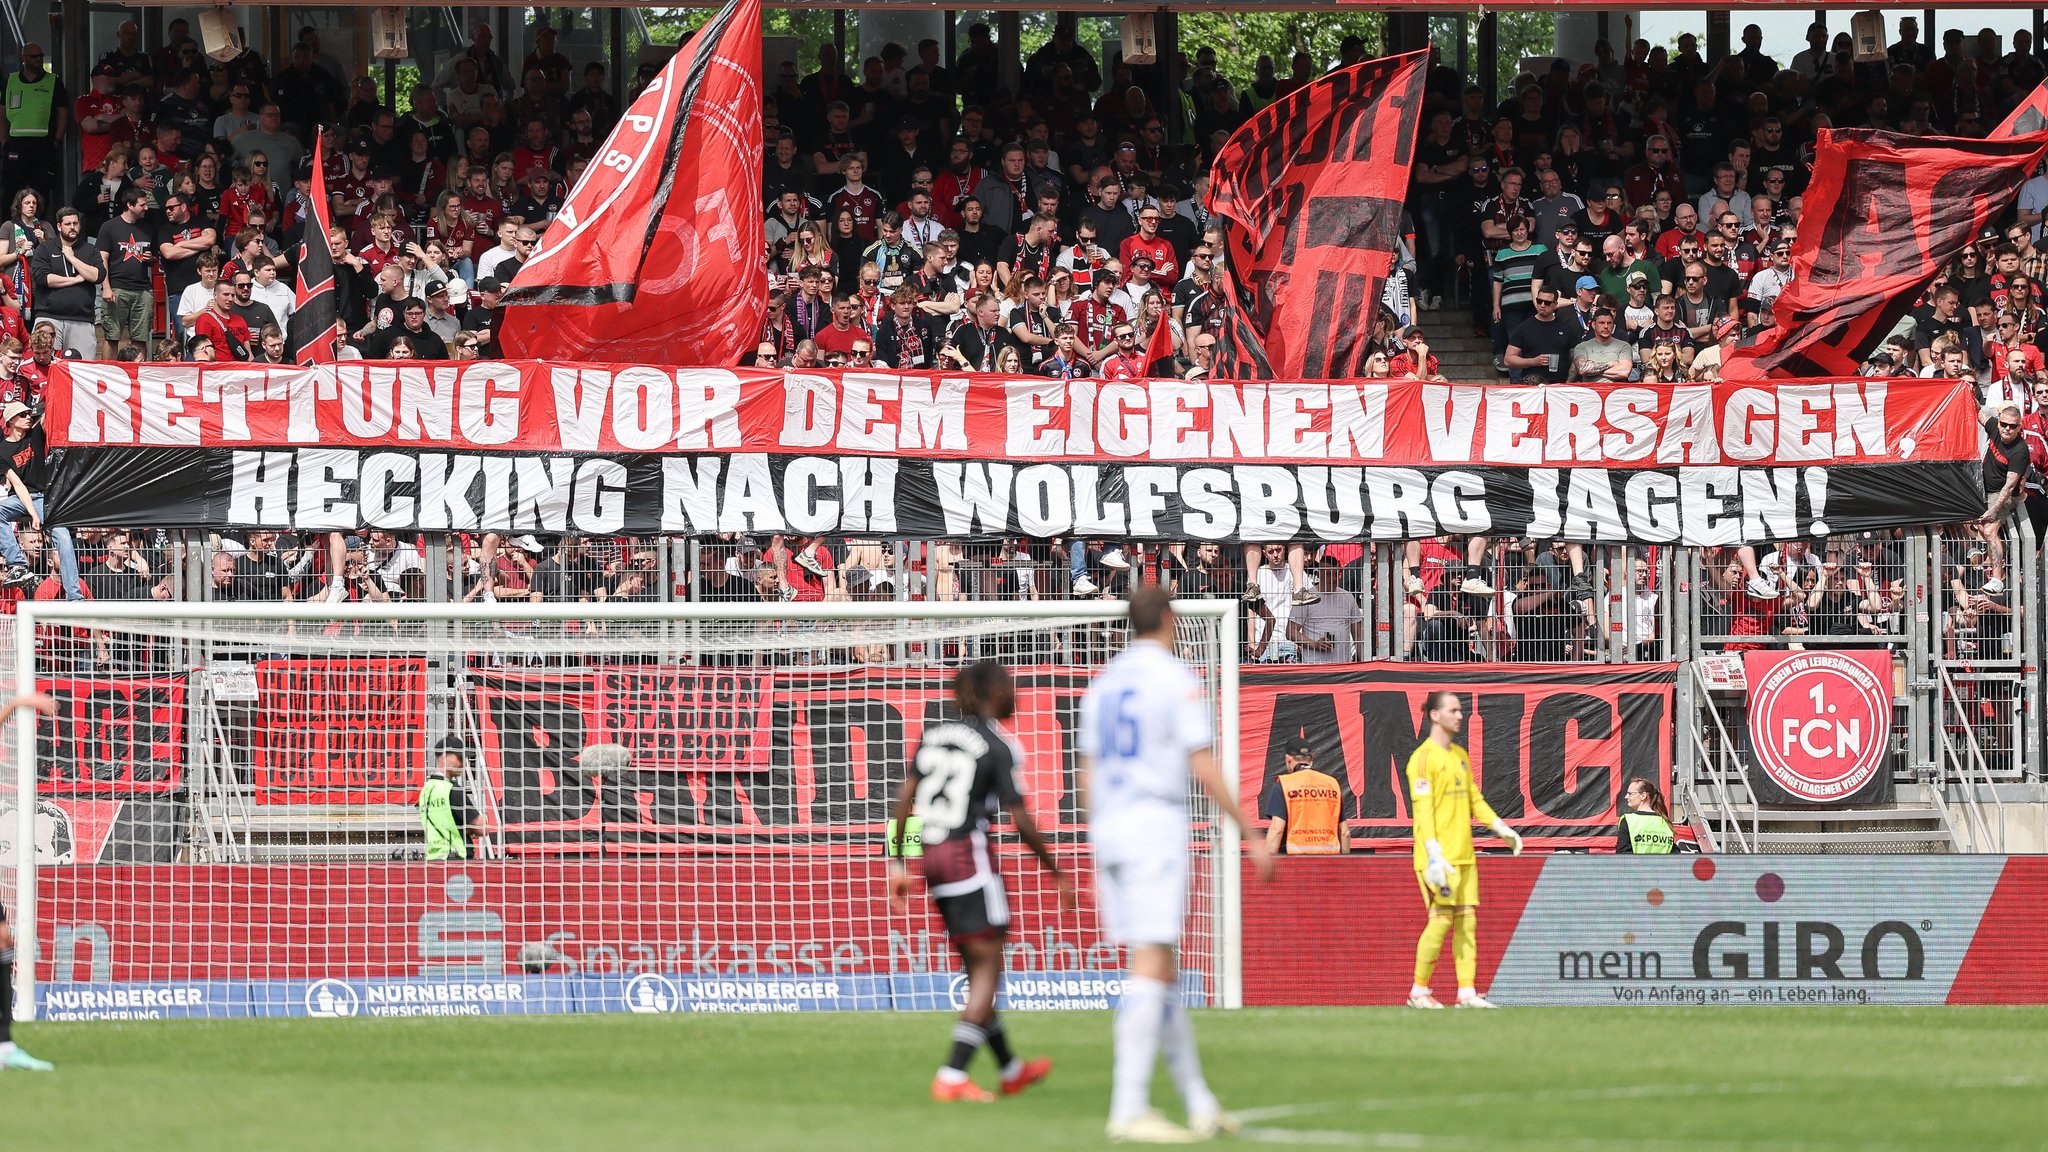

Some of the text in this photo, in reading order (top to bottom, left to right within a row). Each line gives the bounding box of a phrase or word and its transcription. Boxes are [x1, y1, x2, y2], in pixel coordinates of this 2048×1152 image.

[67, 361, 1917, 465] RETTUNG VOR DEM EIGENEN VERSAGEN,
[226, 448, 1831, 547] HECKING NACH WOLFSBURG JAGEN!
[606, 674, 761, 704] SEKTION
[1765, 656, 1875, 691] VEREIN FÜR LEIBESÜBUNGEN
[262, 663, 420, 723] GEMEINSCHAFT
[1809, 681, 1837, 714] 1.
[606, 702, 760, 730] STADION
[262, 725, 316, 783] VOR
[327, 724, 419, 782] PROFIT
[610, 731, 752, 761] VERBOT
[1782, 718, 1860, 759] FCN
[1257, 690, 1665, 820] AMICI
[915, 745, 978, 830] 23
[1774, 765, 1869, 796] EINGETRAGENER VEREIN
[1646, 834, 1674, 846] POWE
[546, 927, 865, 973] Sparkasse
[1558, 948, 1662, 980] mein
[45, 987, 203, 1010] NÜRNBERGER
[367, 983, 523, 1003] NÜRNBERGER
[687, 980, 840, 1000] NÜRNBERGER
[1006, 978, 1134, 997] NÜRNBERGE
[1612, 986, 1645, 1001] Von
[1648, 985, 1706, 1006] Anfang
[1710, 989, 1730, 1001] an
[1748, 986, 1773, 1001] ein
[1778, 985, 1827, 1002] Leben
[1831, 985, 1872, 1006] lang.
[370, 1003, 481, 1016] VERSICHERUNG
[689, 1001, 799, 1013] VERSICHERUNG
[1009, 998, 1109, 1010] VERSICHERUNG
